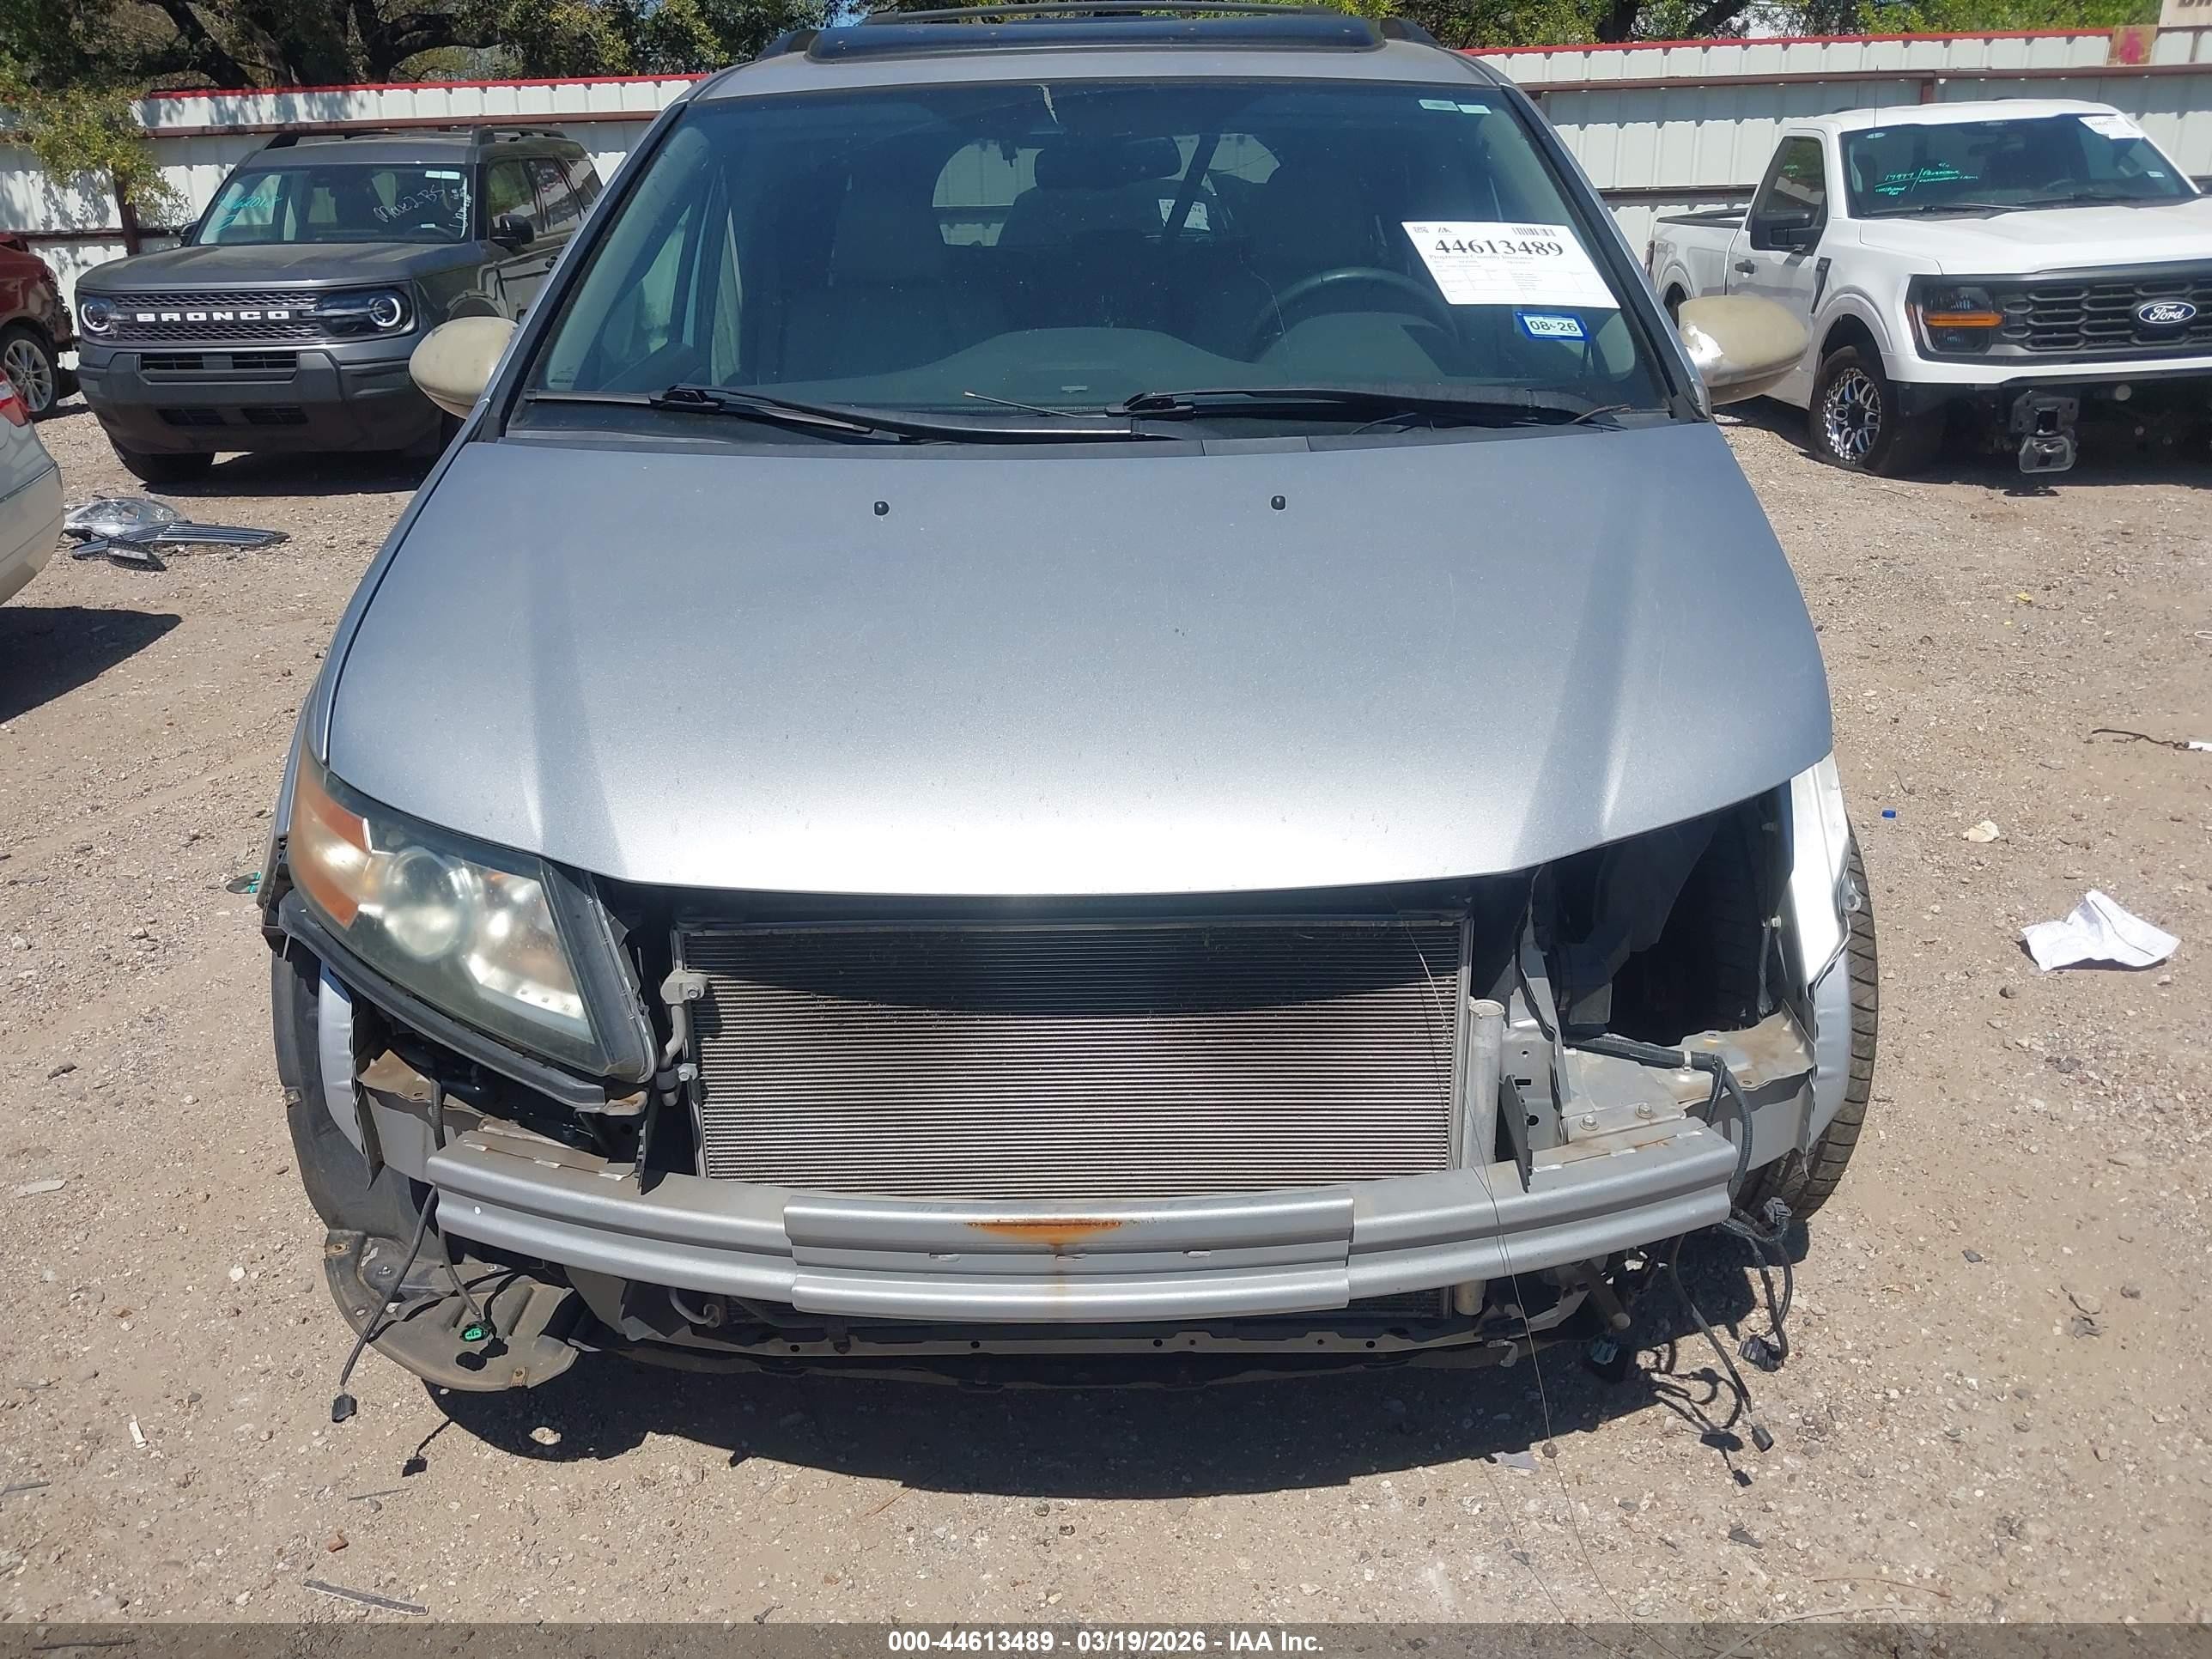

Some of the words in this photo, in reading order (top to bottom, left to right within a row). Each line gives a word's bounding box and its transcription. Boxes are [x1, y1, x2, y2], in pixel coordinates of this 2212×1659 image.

[1435, 240, 1564, 256] 44613489
[136, 311, 289, 322] BRONCO
[2148, 305, 2185, 320] Ford
